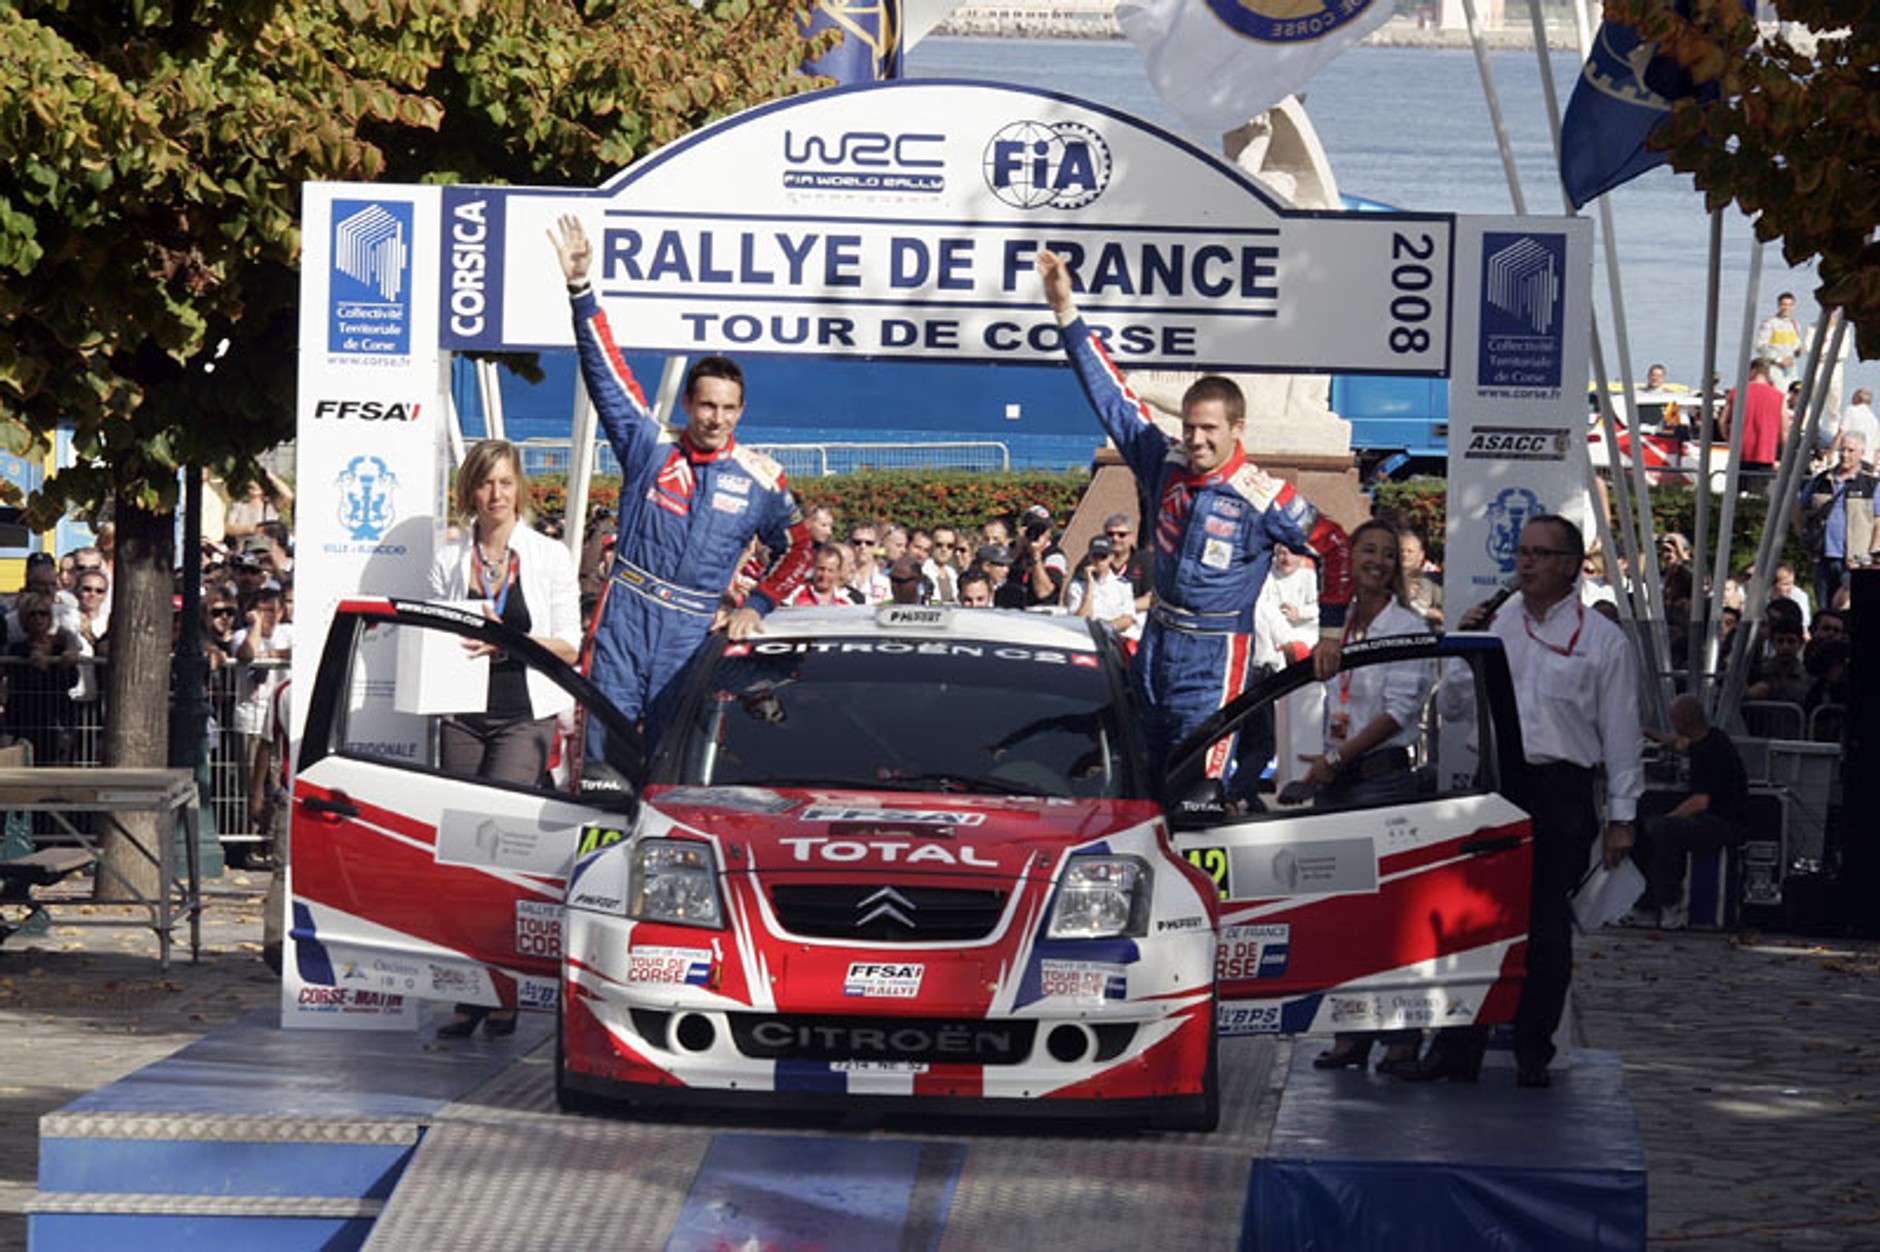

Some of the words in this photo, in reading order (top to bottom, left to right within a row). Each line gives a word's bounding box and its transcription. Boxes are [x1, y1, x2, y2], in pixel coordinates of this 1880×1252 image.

[785, 130, 946, 166] WRC
[784, 174, 814, 186] FIA
[815, 175, 879, 188] WORLD
[883, 177, 944, 190] RALLY
[451, 200, 487, 337] CORSICA
[602, 228, 861, 287] RALLYE
[890, 236, 974, 291] DE
[1003, 240, 1279, 299] FRANCE
[1389, 232, 1434, 353] 2008
[682, 313, 855, 347] TOUR
[881, 319, 959, 349] DE
[343, 337, 358, 350] de
[360, 338, 396, 351] Corse
[327, 356, 412, 368] www.corse.fr
[1494, 371, 1508, 383] de
[1510, 371, 1546, 384] Corse
[1469, 435, 1548, 451] ASACC
[755, 641, 984, 657] CITROËN
[994, 648, 1067, 664] C2
[579, 779, 622, 791] TOTAL
[1182, 801, 1223, 812] TOTAL
[778, 838, 998, 868] TOTAL
[519, 917, 562, 936] TOUR
[1243, 926, 1286, 937] FRANCE
[1235, 942, 1257, 957] DE
[631, 957, 664, 968] TOUR
[668, 958, 686, 969] DE
[628, 967, 684, 984] CORSE
[851, 965, 914, 978] FFSA
[1044, 970, 1079, 982] TOUR
[1043, 980, 1101, 997] CORSE
[752, 1021, 1010, 1053] CITROËN
